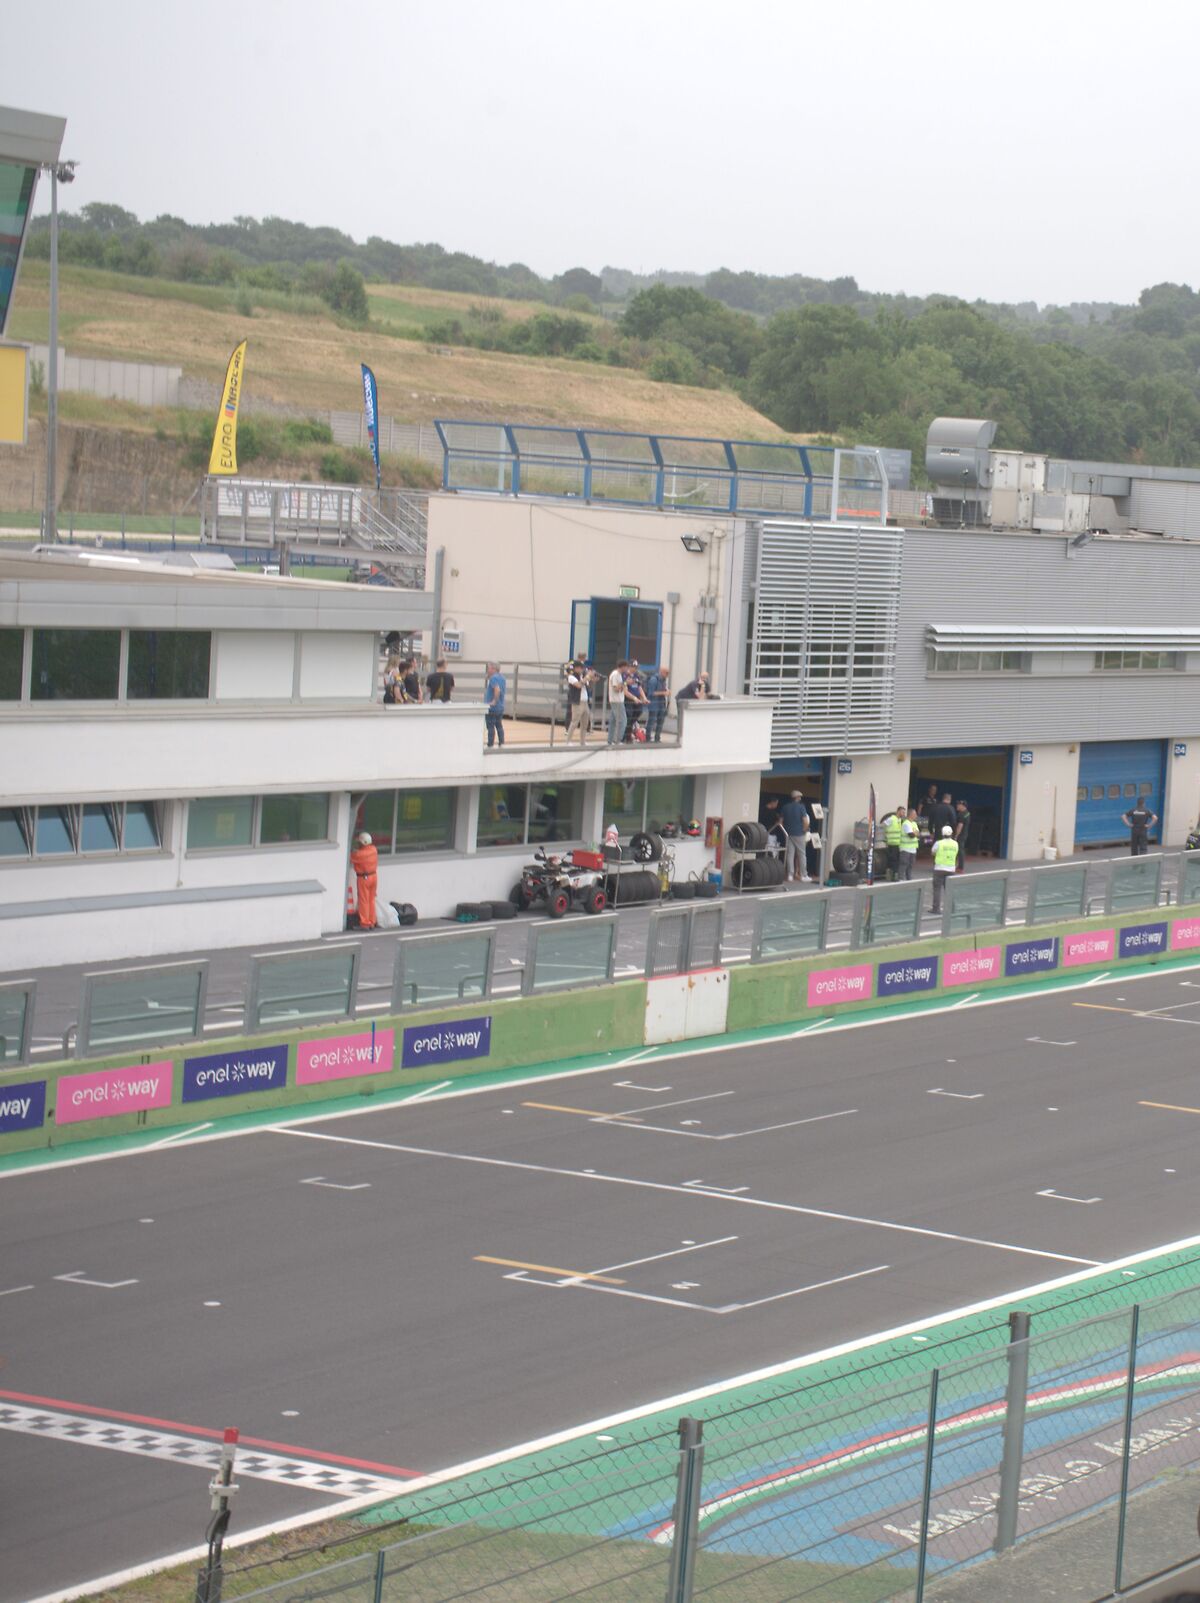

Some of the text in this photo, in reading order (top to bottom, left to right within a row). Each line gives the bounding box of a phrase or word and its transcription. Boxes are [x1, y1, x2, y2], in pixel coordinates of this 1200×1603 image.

[221, 423, 233, 469] EURO
[839, 762, 851, 771] 26
[1021, 753, 1032, 762] 25
[1125, 931, 1163, 947] enel way
[1177, 926, 1193, 940] enel
[1012, 946, 1053, 965] enel way
[1069, 939, 1110, 956] enel way
[950, 957, 994, 975] enel way
[885, 966, 932, 985] enel way
[816, 976, 865, 994] enel way
[414, 1031, 481, 1053] enel way
[309, 1045, 383, 1069] enel way
[196, 1061, 276, 1086] enel way
[72, 1078, 159, 1105] enel way
